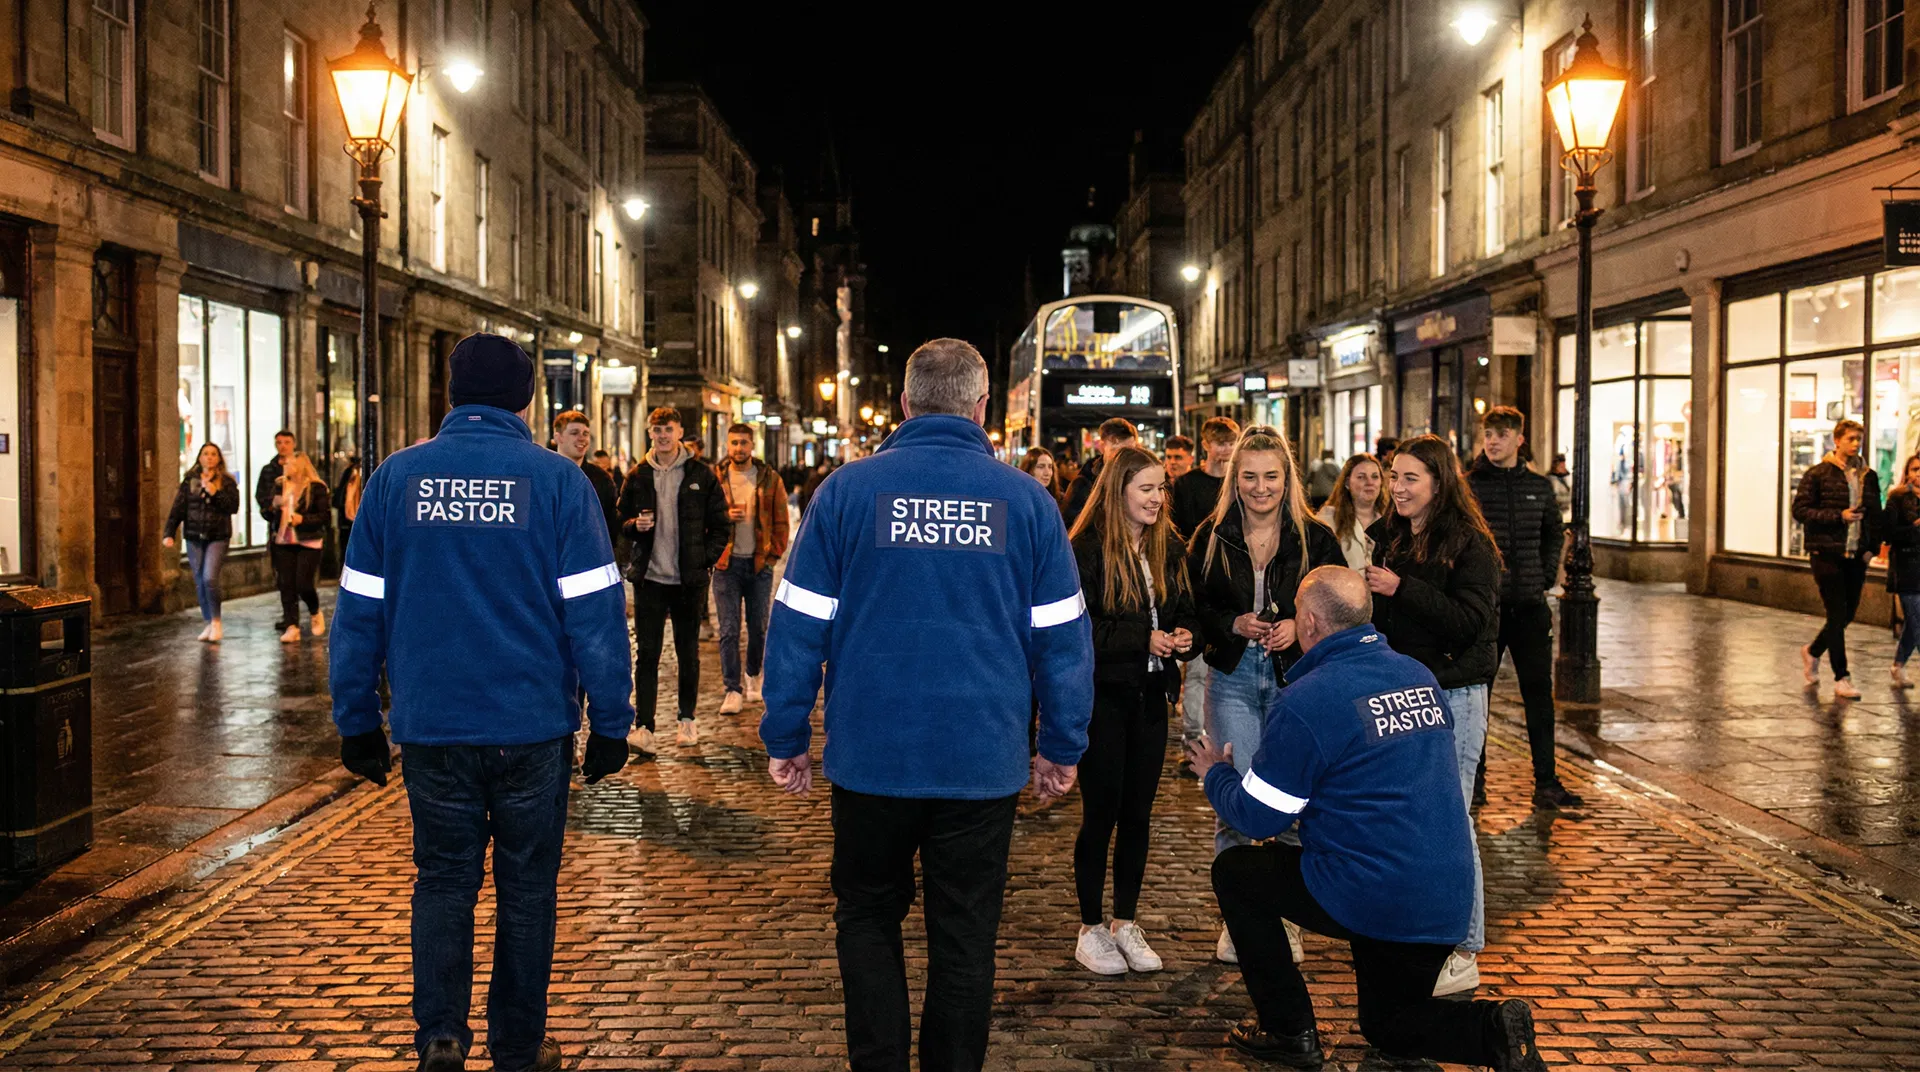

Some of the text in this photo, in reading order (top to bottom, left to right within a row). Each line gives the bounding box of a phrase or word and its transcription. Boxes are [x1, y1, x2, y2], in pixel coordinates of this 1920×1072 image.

[418, 478, 516, 500] STREET
[416, 501, 516, 523] PASTOR
[892, 498, 993, 522] STREET
[890, 521, 993, 547] PASTOR
[1368, 686, 1437, 716] STREET
[1374, 706, 1446, 737] PASTOR
